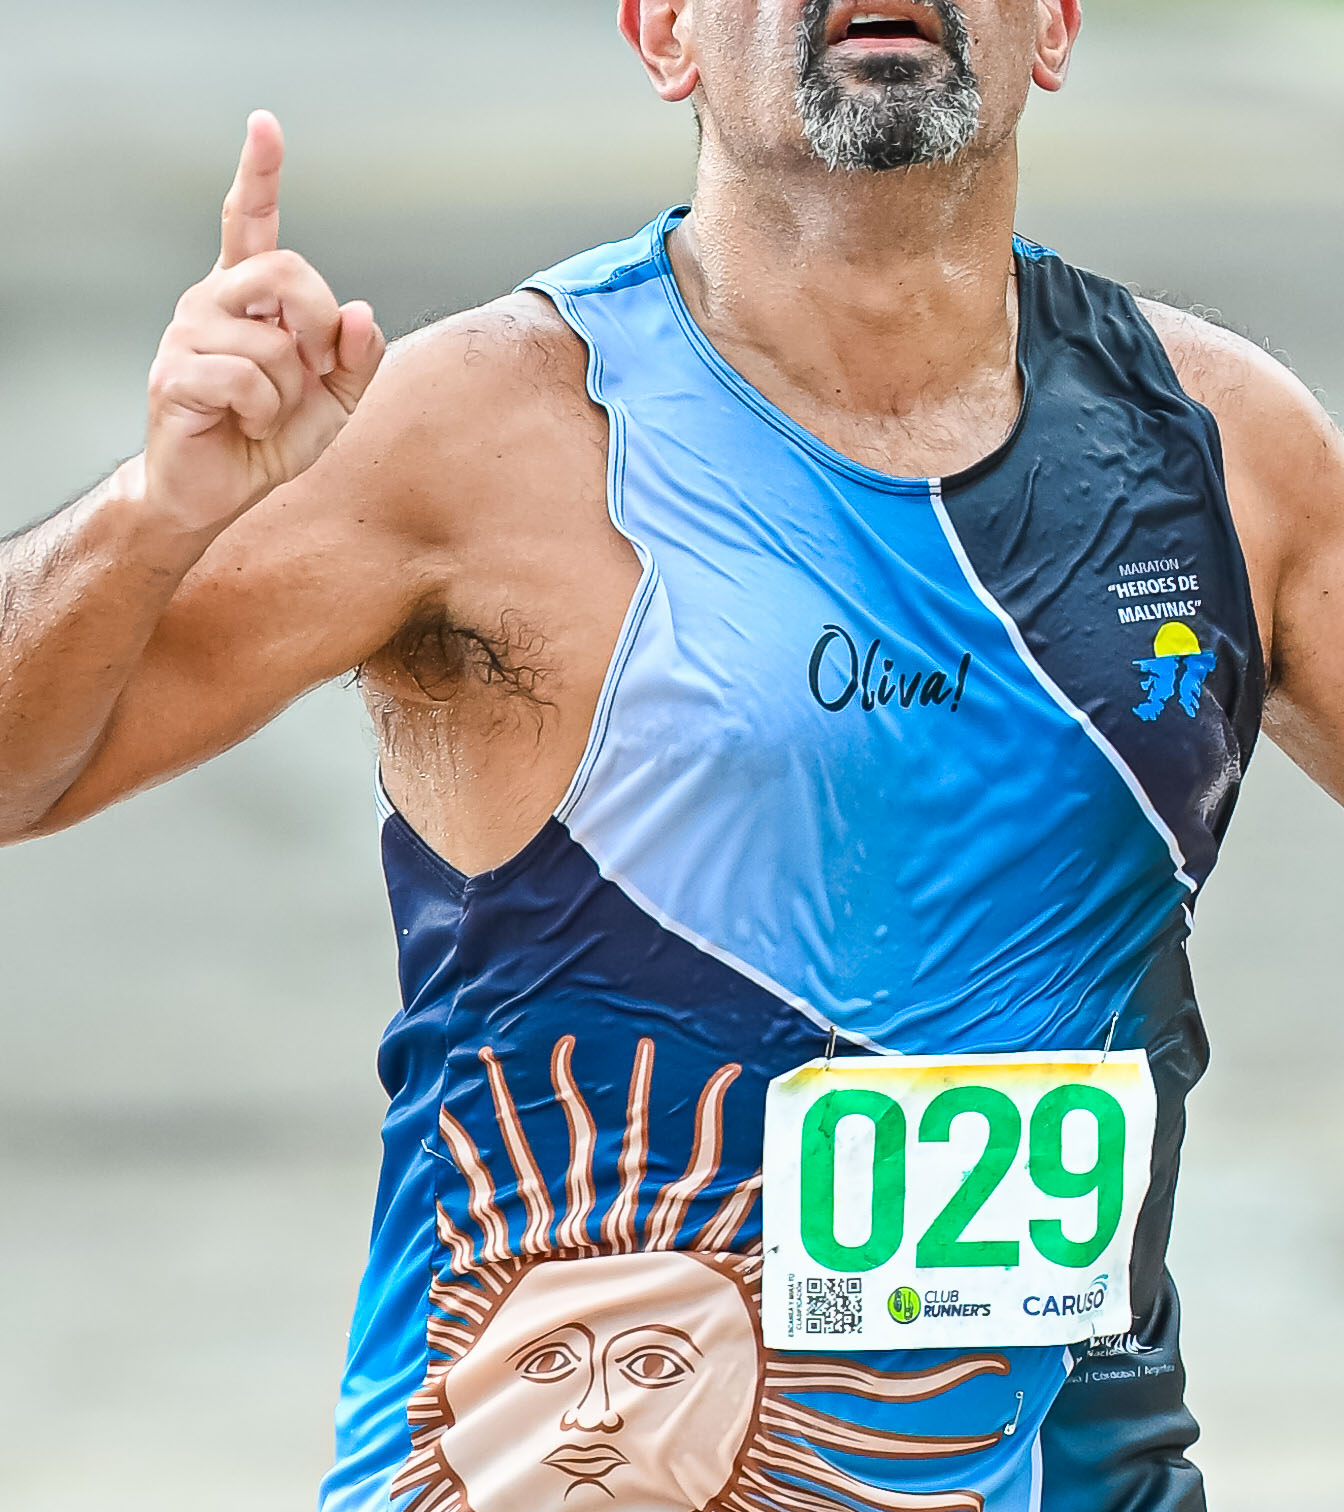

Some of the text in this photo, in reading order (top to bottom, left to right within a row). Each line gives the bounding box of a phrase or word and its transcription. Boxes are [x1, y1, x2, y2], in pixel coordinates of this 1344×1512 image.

[1178, 574, 1200, 591] DE
[808, 623, 972, 713] Oliva!
[800, 1083, 1126, 1273] 029
[924, 1290, 960, 1303] CLUB
[1022, 1288, 1104, 1317] CARUSO
[924, 1303, 992, 1318] RUNNER'S
